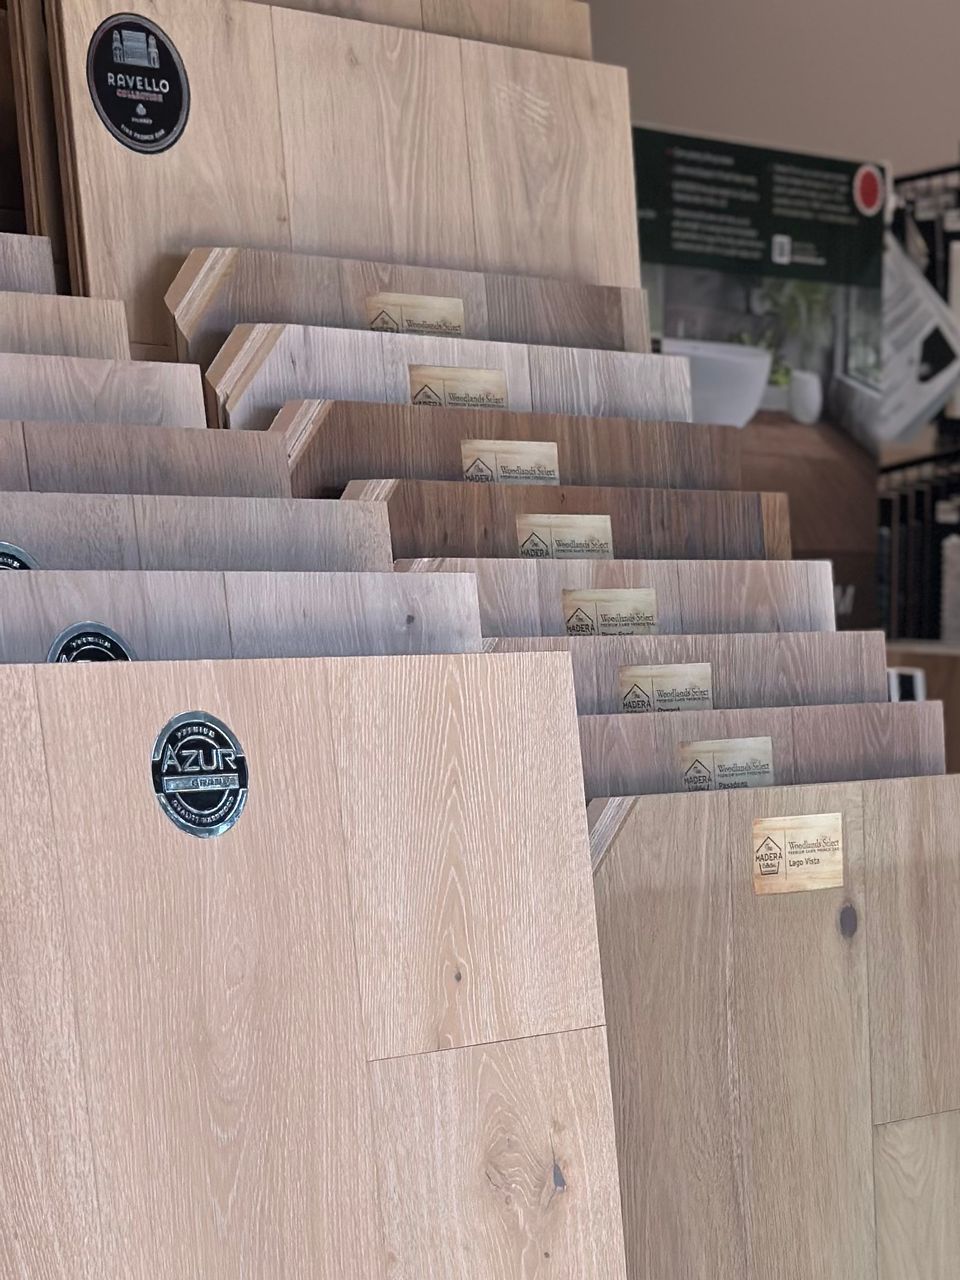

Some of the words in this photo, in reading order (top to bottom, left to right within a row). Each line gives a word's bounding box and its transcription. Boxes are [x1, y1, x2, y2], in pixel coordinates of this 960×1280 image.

[107, 72, 170, 93] RAVELLO
[520, 548, 550, 558] MADERA
[566, 622, 596, 633] MADERA
[656, 687, 690, 698] Woodlands
[692, 686, 709, 697] Select
[623, 699, 652, 710] MADERA
[161, 743, 238, 773] AZUR
[717, 762, 752, 773] Woodlands
[684, 775, 713, 785] MADERA
[787, 839, 822, 851] Woodlands
[823, 836, 840, 849] Select
[755, 852, 783, 863] MADERA
[788, 859, 804, 868] Lago
[804, 857, 820, 866] Vista
